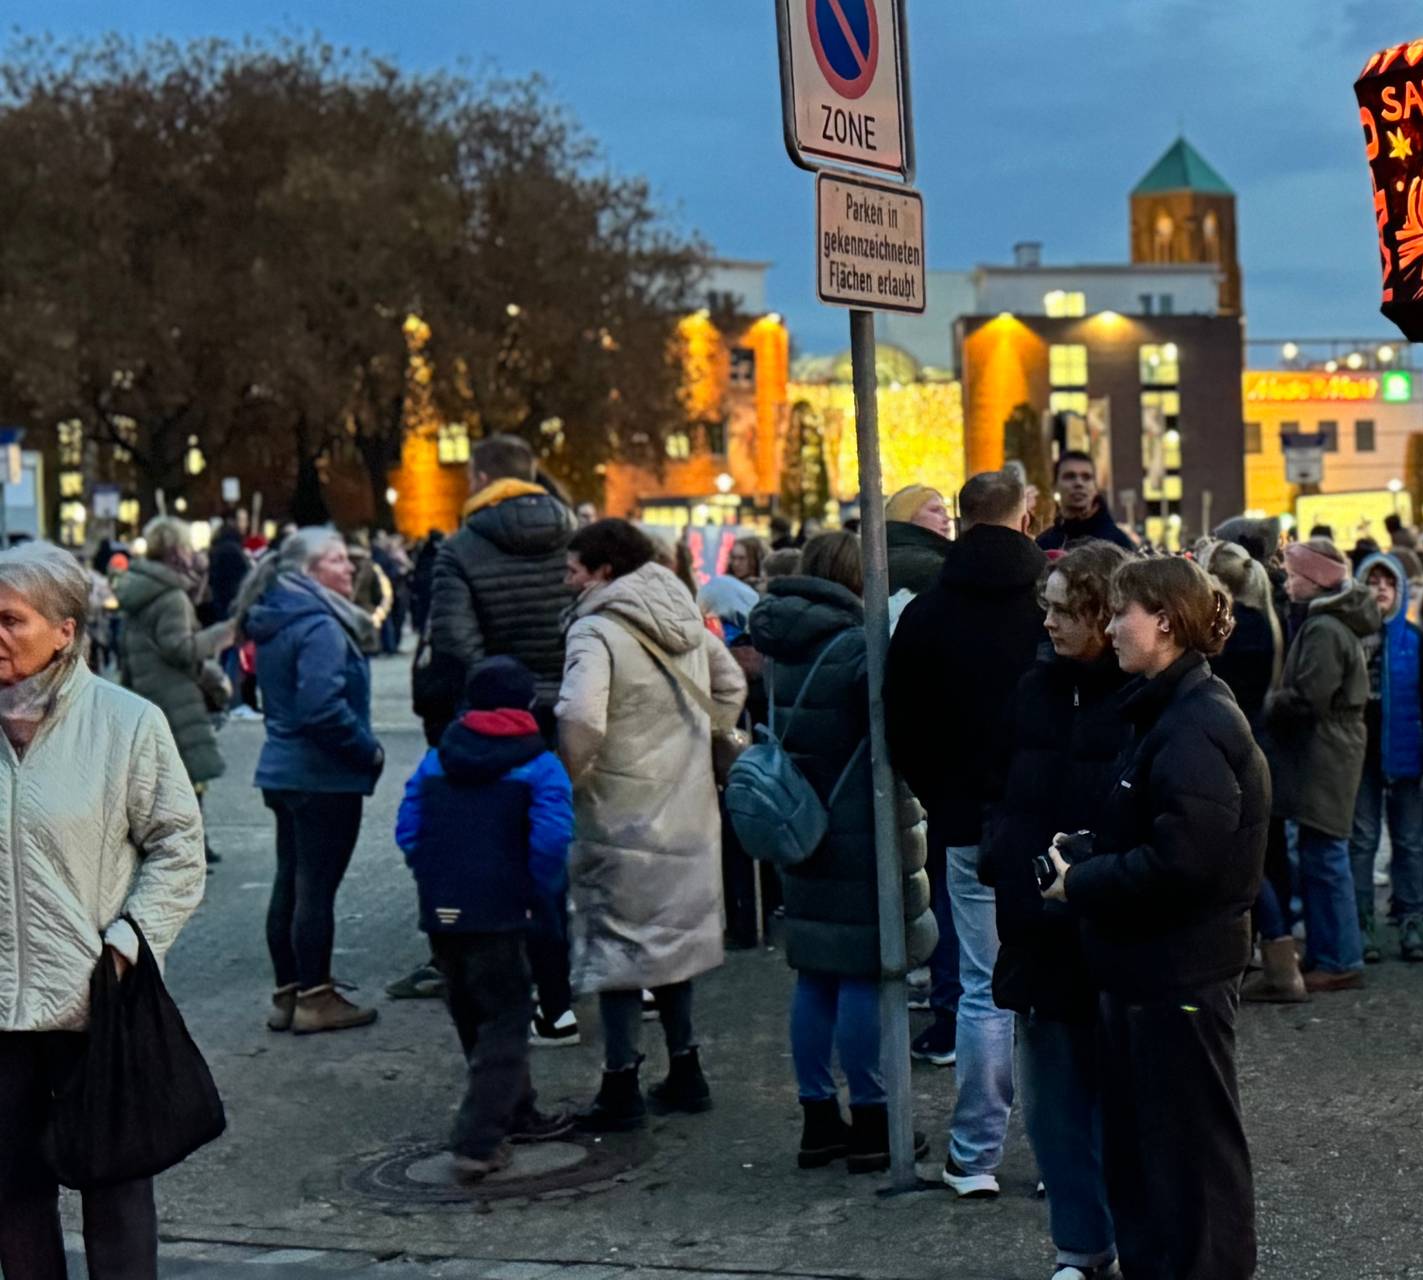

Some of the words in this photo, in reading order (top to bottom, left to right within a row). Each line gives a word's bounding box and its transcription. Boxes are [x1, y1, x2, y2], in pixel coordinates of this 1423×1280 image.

[821, 104, 877, 151] ZONE
[846, 193, 883, 226] Parken
[888, 201, 898, 228] in
[824, 226, 920, 266] gekennzeichneten
[829, 261, 872, 293] Flächen
[878, 271, 916, 302] erlaubt
